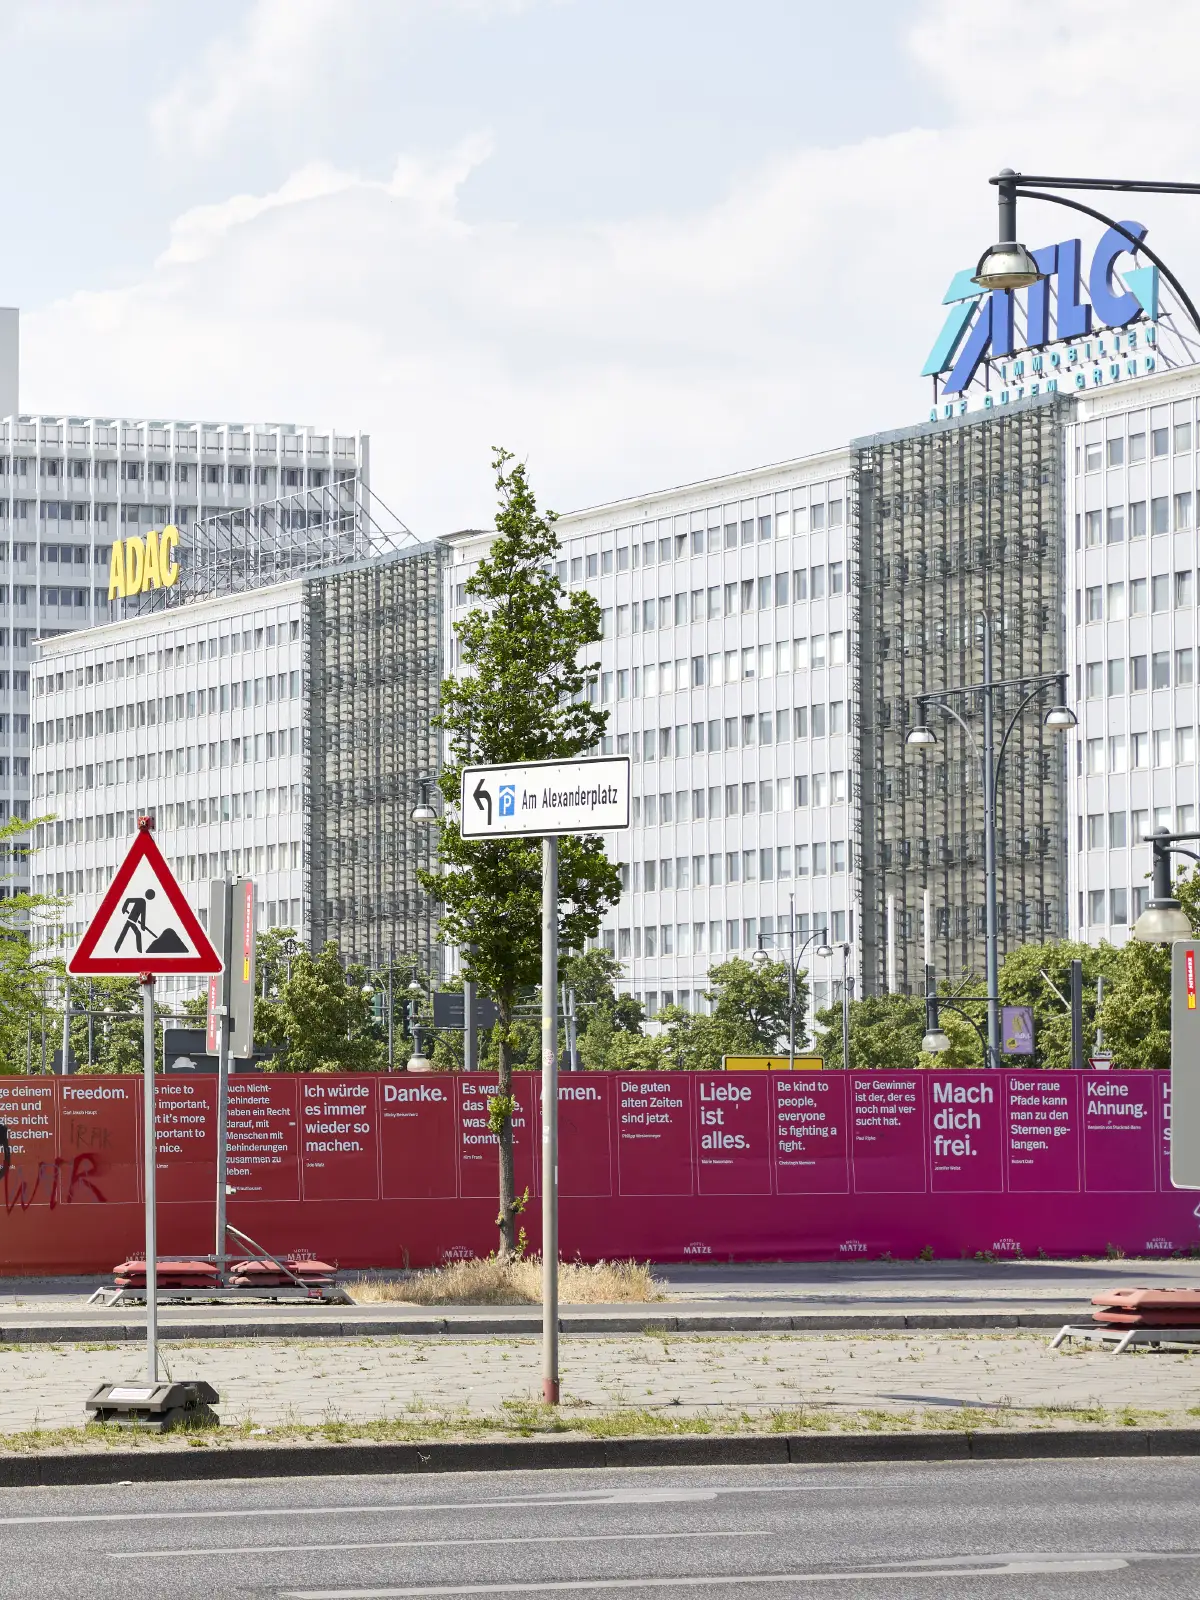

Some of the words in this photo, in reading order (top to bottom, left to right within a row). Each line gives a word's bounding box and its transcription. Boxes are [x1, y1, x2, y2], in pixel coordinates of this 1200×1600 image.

[1001, 327, 1156, 380] IMMOBILIEN
[930, 401, 967, 422] AUF
[984, 379, 1057, 409] GUTEM
[1075, 355, 1155, 389] GRUND
[108, 525, 180, 600] ADAC
[522, 789, 537, 810] Am
[542, 783, 618, 810] Alexanderplatz
[161, 1085, 182, 1094] nice
[183, 1085, 194, 1094] to
[247, 1084, 271, 1093] Nicht-
[304, 1085, 324, 1097] Ich
[328, 1084, 369, 1097] würde
[462, 1083, 476, 1094] Es
[621, 1082, 638, 1092] Die
[640, 1082, 670, 1094] guten
[777, 1082, 792, 1092] Be
[793, 1081, 816, 1092] kind
[818, 1082, 829, 1092] to
[855, 1081, 871, 1090] Der
[872, 1080, 916, 1090] Gewinner
[1010, 1079, 1035, 1091] Über
[1037, 1081, 1060, 1091] raue
[1087, 1082, 1128, 1096] Keine
[12, 1086, 52, 1097] deinem
[63, 1086, 129, 1100] Freedom.
[384, 1085, 448, 1102] Danke.
[700, 1082, 751, 1101] Liebe
[933, 1082, 993, 1103] Mach
[621, 1097, 648, 1108] alten
[649, 1097, 683, 1108] Zeiten
[778, 1096, 817, 1108] people,
[855, 1093, 867, 1102] ist
[869, 1093, 886, 1103] der,
[888, 1093, 903, 1102] der
[905, 1094, 915, 1102] es
[1010, 1095, 1040, 1105] Pfade
[1042, 1095, 1067, 1105] kann
[21, 1101, 42, 1111] und
[159, 1099, 210, 1110] important,
[305, 1105, 321, 1116] es
[323, 1102, 366, 1116] immer
[463, 1100, 484, 1111] das
[855, 1105, 879, 1114] noch
[880, 1105, 897, 1114] mal
[1087, 1100, 1148, 1118] Ahnung.
[266, 1108, 290, 1116] Recht
[700, 1106, 724, 1125] ist
[778, 1112, 825, 1122] everyone
[1010, 1111, 1032, 1120] man
[1035, 1111, 1046, 1120] zu
[1049, 1110, 1068, 1120] den
[21, 1115, 49, 1125] nicht
[179, 1115, 206, 1123] more
[226, 1120, 255, 1128] darauf,
[256, 1119, 269, 1128] mit
[463, 1118, 486, 1127] was
[622, 1113, 644, 1123] sind
[646, 1113, 673, 1125] jetzt.
[855, 1117, 881, 1126] sucht
[883, 1117, 901, 1126] hat.
[933, 1108, 981, 1130] dich
[195, 1129, 205, 1138] to
[305, 1122, 350, 1134] wieder
[353, 1123, 370, 1133] so
[778, 1125, 788, 1136] is
[790, 1125, 829, 1137] fighting
[830, 1127, 837, 1135] a
[1010, 1124, 1051, 1135] Sternen
[1053, 1127, 1070, 1137] ge-
[226, 1132, 268, 1140] Menschen
[269, 1131, 283, 1140] mit
[701, 1131, 750, 1149] alles.
[160, 1144, 183, 1153] nice.
[226, 1144, 288, 1152] Behinderungen
[306, 1140, 363, 1152] machen.
[778, 1140, 806, 1152] fight.
[934, 1134, 977, 1156] frei.
[1011, 1138, 1048, 1151] langen.
[226, 1156, 270, 1164] zusammen
[226, 1167, 252, 1175] leben.
[3, 1152, 108, 1215] WIR
[684, 1246, 712, 1254] MATZE
[839, 1244, 868, 1252] MATZE
[992, 1242, 1021, 1250] MATZE
[1146, 1241, 1173, 1249] MATZE
[288, 1253, 317, 1261] MATZE
[444, 1250, 474, 1258] MATZE
